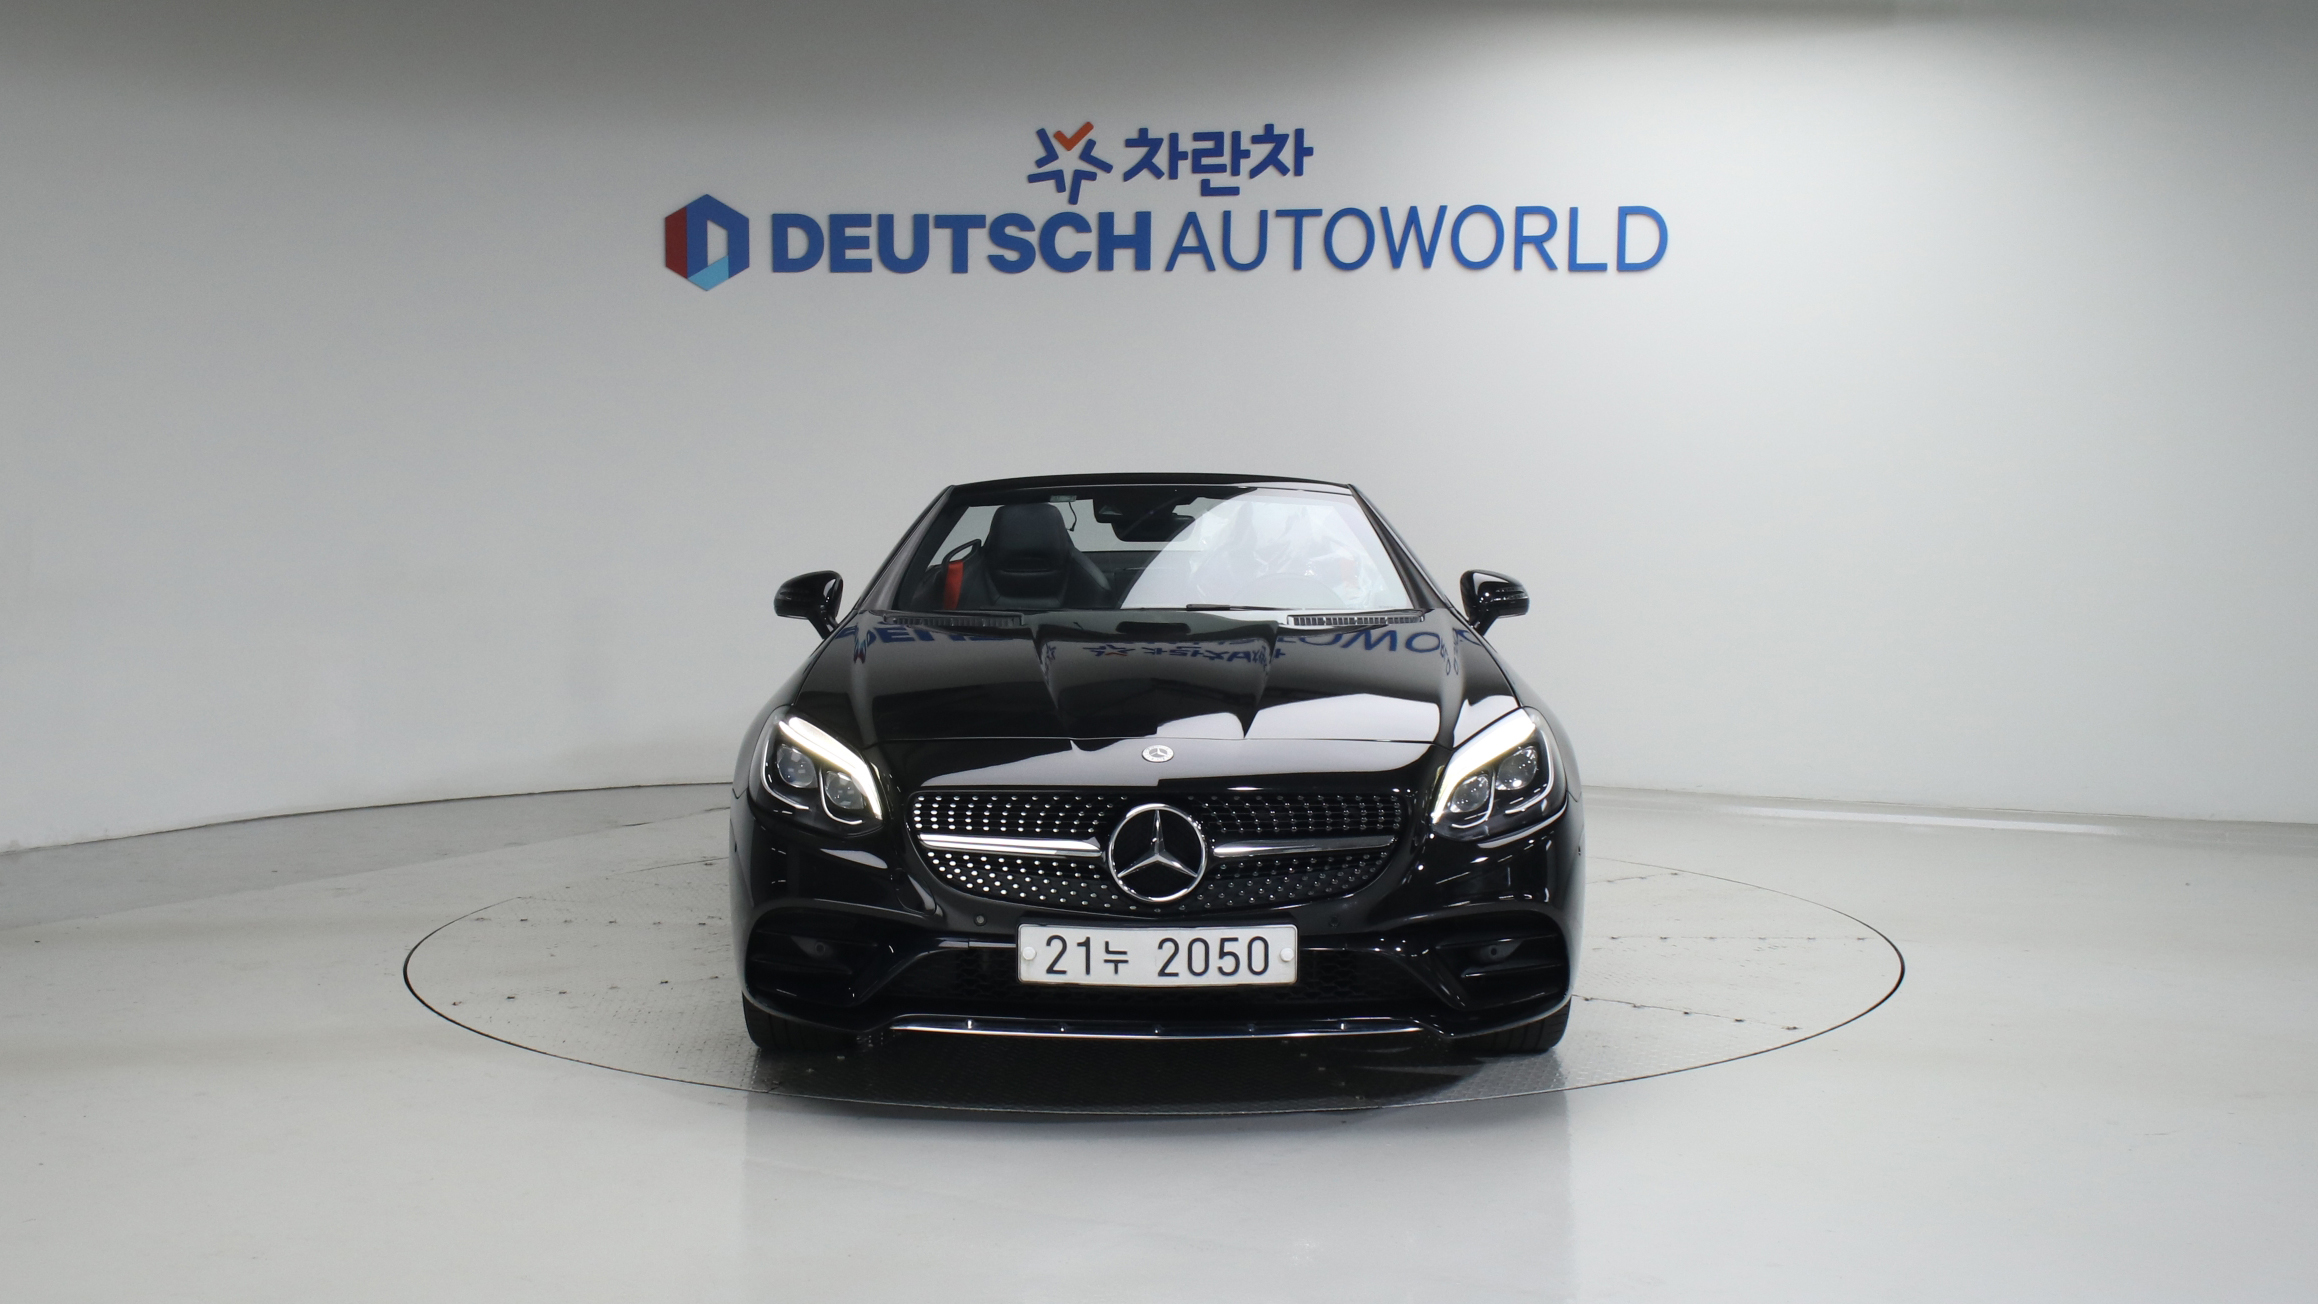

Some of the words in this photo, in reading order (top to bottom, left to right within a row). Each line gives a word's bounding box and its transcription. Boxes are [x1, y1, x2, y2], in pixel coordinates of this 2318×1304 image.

[1124, 123, 1314, 195] 차란차
[771, 210, 1153, 273] DEUTSCH
[1166, 203, 1670, 271] AUTOWORLD
[1046, 934, 1129, 976] 21누
[1157, 936, 1269, 977] 2050
